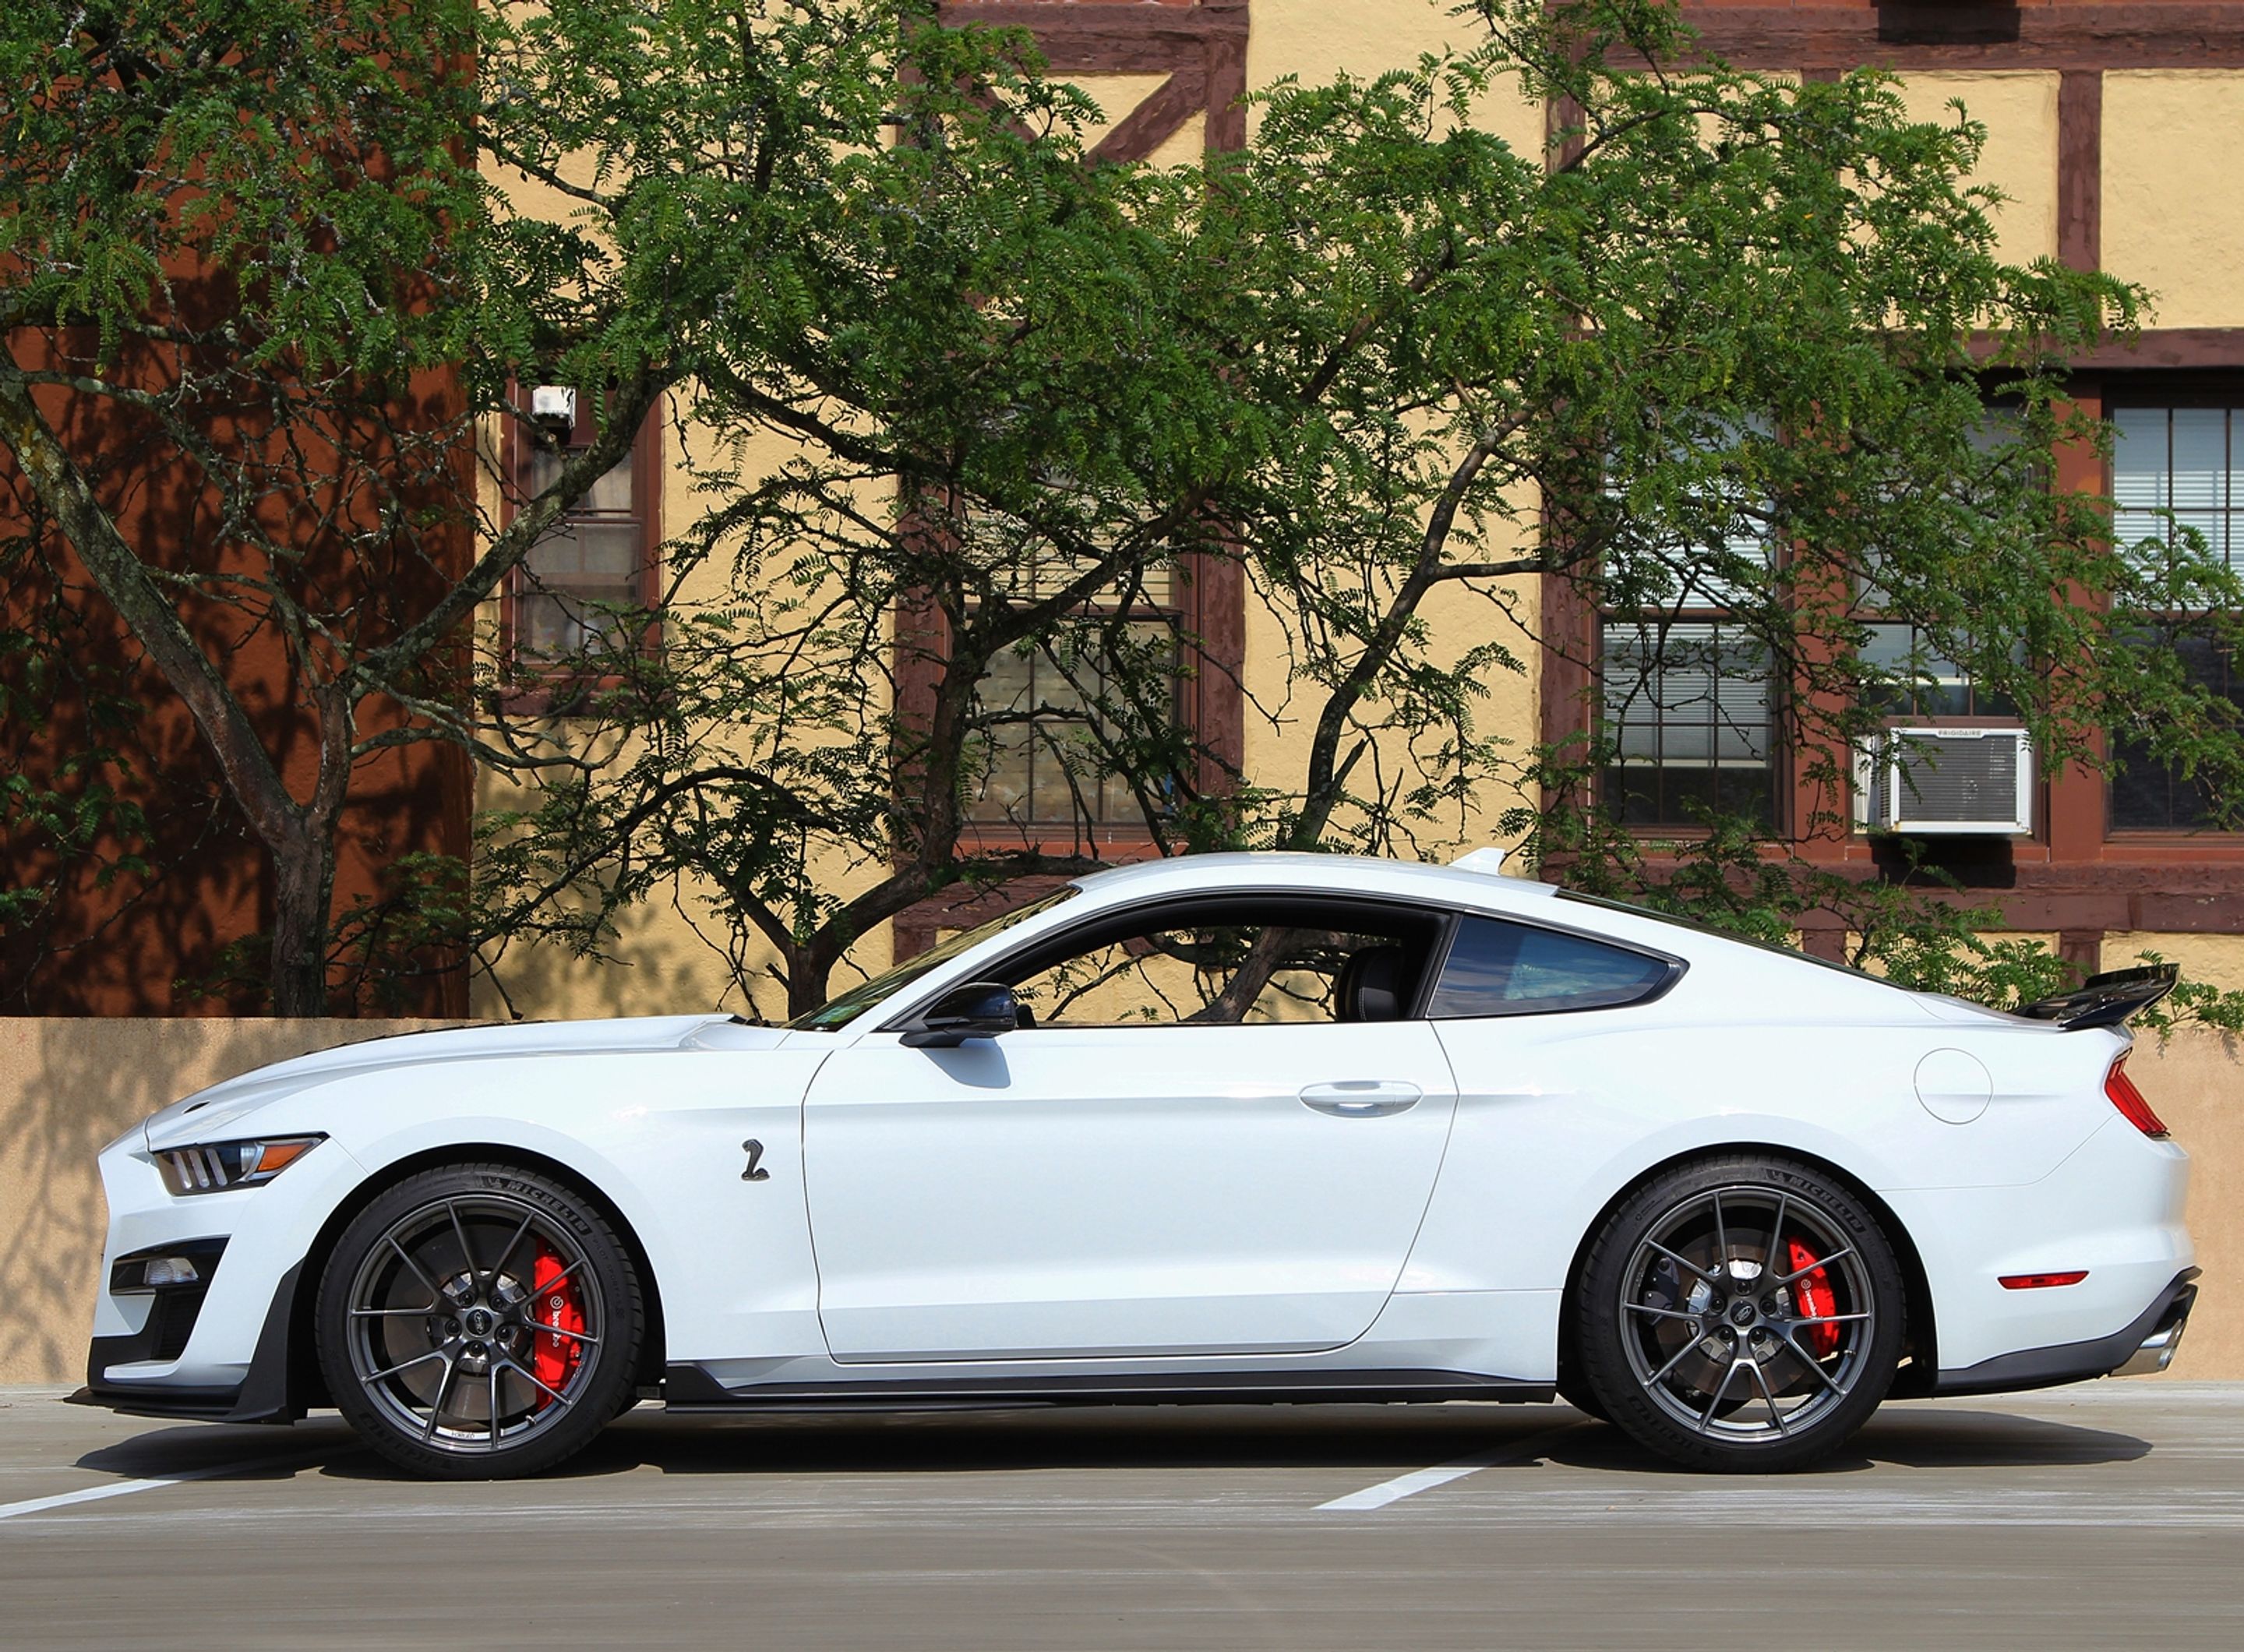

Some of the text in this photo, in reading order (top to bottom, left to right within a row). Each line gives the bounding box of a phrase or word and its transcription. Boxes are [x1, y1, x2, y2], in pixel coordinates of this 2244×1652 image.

[506, 1181, 588, 1234] MICHELIN
[1790, 1175, 1863, 1231] MICHELIN
[552, 1310, 562, 1347] brebo
